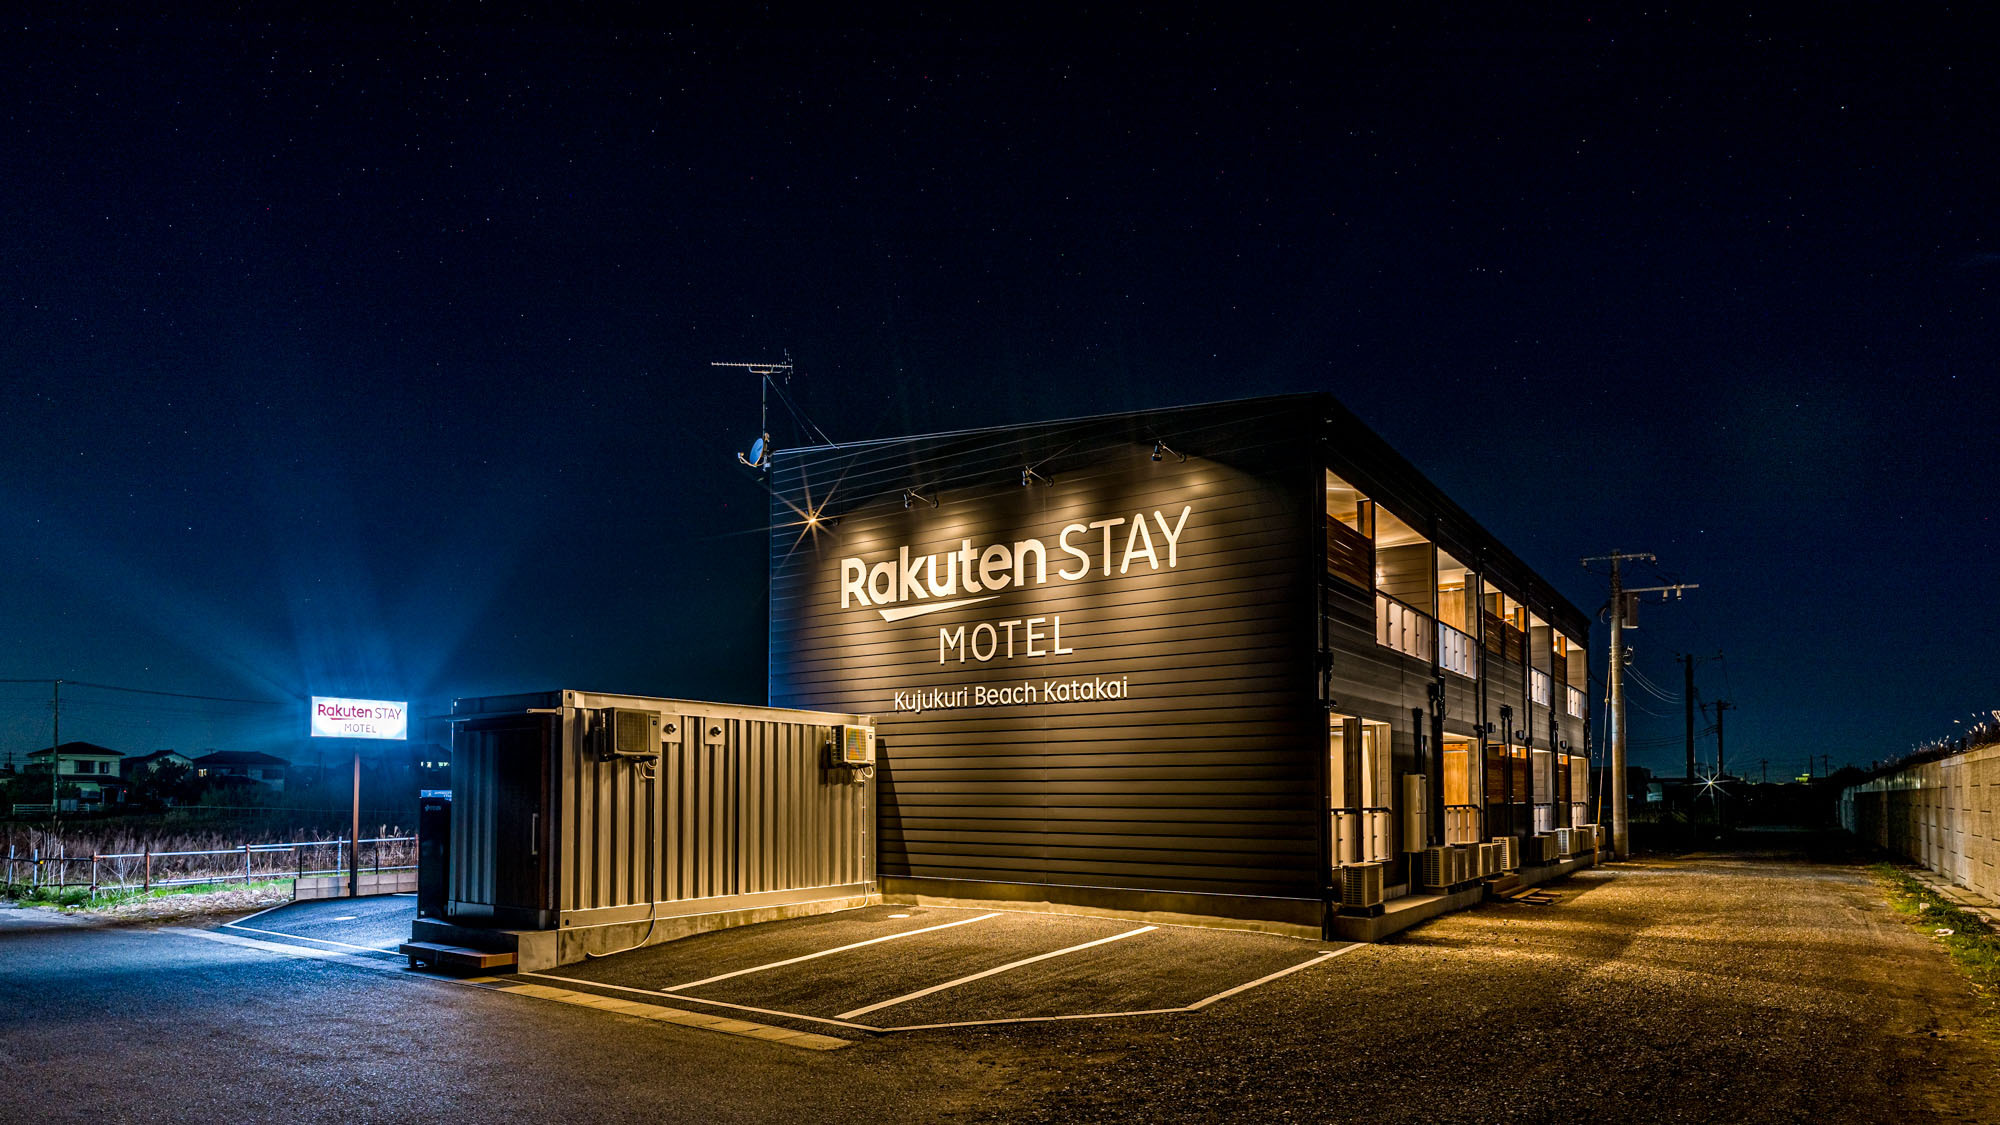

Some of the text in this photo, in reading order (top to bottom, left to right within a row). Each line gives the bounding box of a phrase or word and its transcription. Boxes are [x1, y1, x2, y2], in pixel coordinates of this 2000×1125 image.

[840, 505, 1193, 610] Rakuten STAY
[939, 615, 1074, 665] MOTEL
[318, 703, 402, 720] Rakuten STAY
[894, 675, 1129, 713] Kujukuri Beach Katakai
[344, 723, 377, 733] MOTEL
